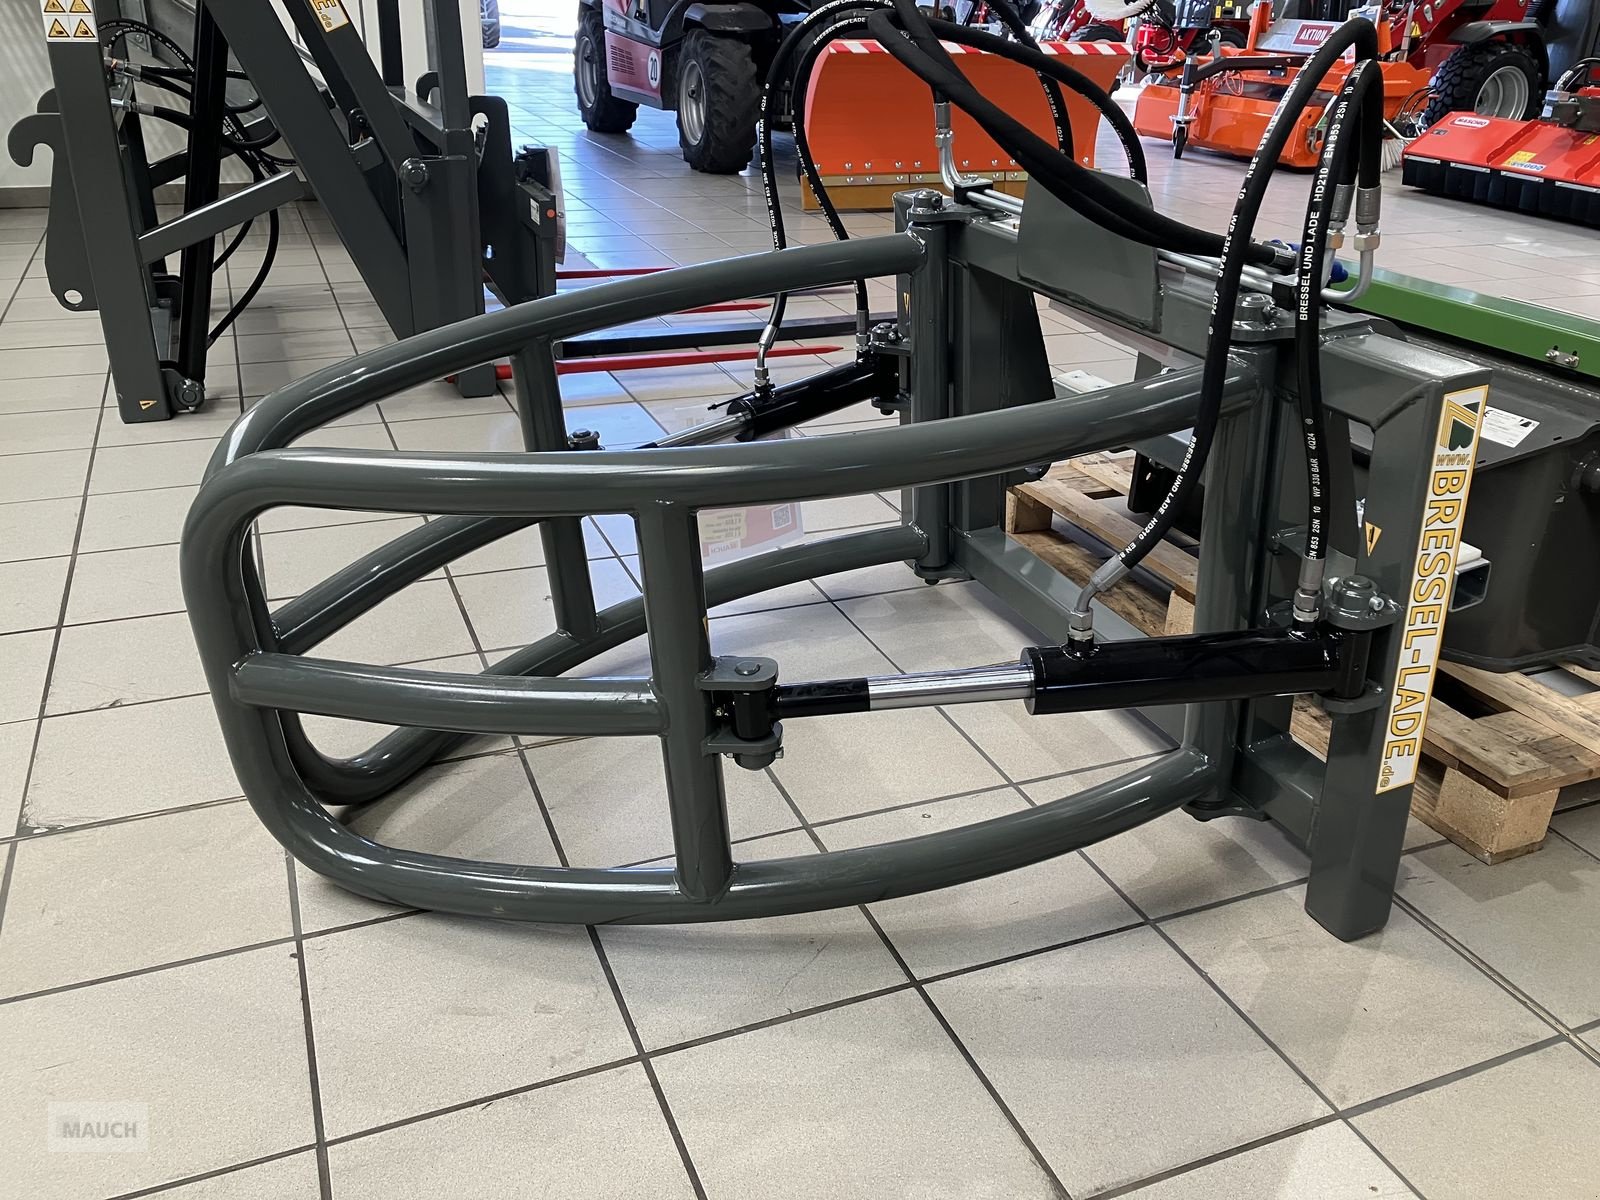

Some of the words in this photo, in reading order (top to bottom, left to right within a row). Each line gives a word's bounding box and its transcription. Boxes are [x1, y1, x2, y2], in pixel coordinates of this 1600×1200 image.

[1299, 28, 1328, 41] AKTION
[649, 56, 658, 82] 20
[1343, 86, 1354, 95] 10
[1335, 101, 1348, 119] 2SN
[1329, 124, 1341, 141] 853
[1324, 143, 1335, 159] EN
[1246, 157, 1259, 178] 2SN
[1238, 187, 1247, 200] 10
[1314, 167, 1329, 202] HD210
[767, 197, 773, 207] EN
[769, 209, 777, 228] HD210
[1229, 214, 1239, 232] WP
[1306, 211, 1320, 245] LADE
[1222, 235, 1232, 253] 330
[1217, 255, 1227, 278] BAR
[1302, 245, 1314, 270] UND
[1210, 290, 1219, 315] 4Q24
[1299, 272, 1311, 321] BRESSEL
[1308, 432, 1317, 450] 4Q24
[1180, 435, 1197, 472] BRESSEL
[1435, 453, 1471, 467] www.
[1310, 458, 1320, 473] BAR
[1171, 474, 1184, 493] UND
[1312, 474, 1320, 485] 330
[1313, 486, 1321, 498] WP
[1158, 492, 1174, 515] LADE
[1313, 505, 1321, 514] 10
[1138, 517, 1158, 540] HD210
[1312, 519, 1321, 534] 2SN
[1126, 542, 1137, 554] EN
[1310, 536, 1319, 550] 853
[1308, 550, 1318, 560] EN
